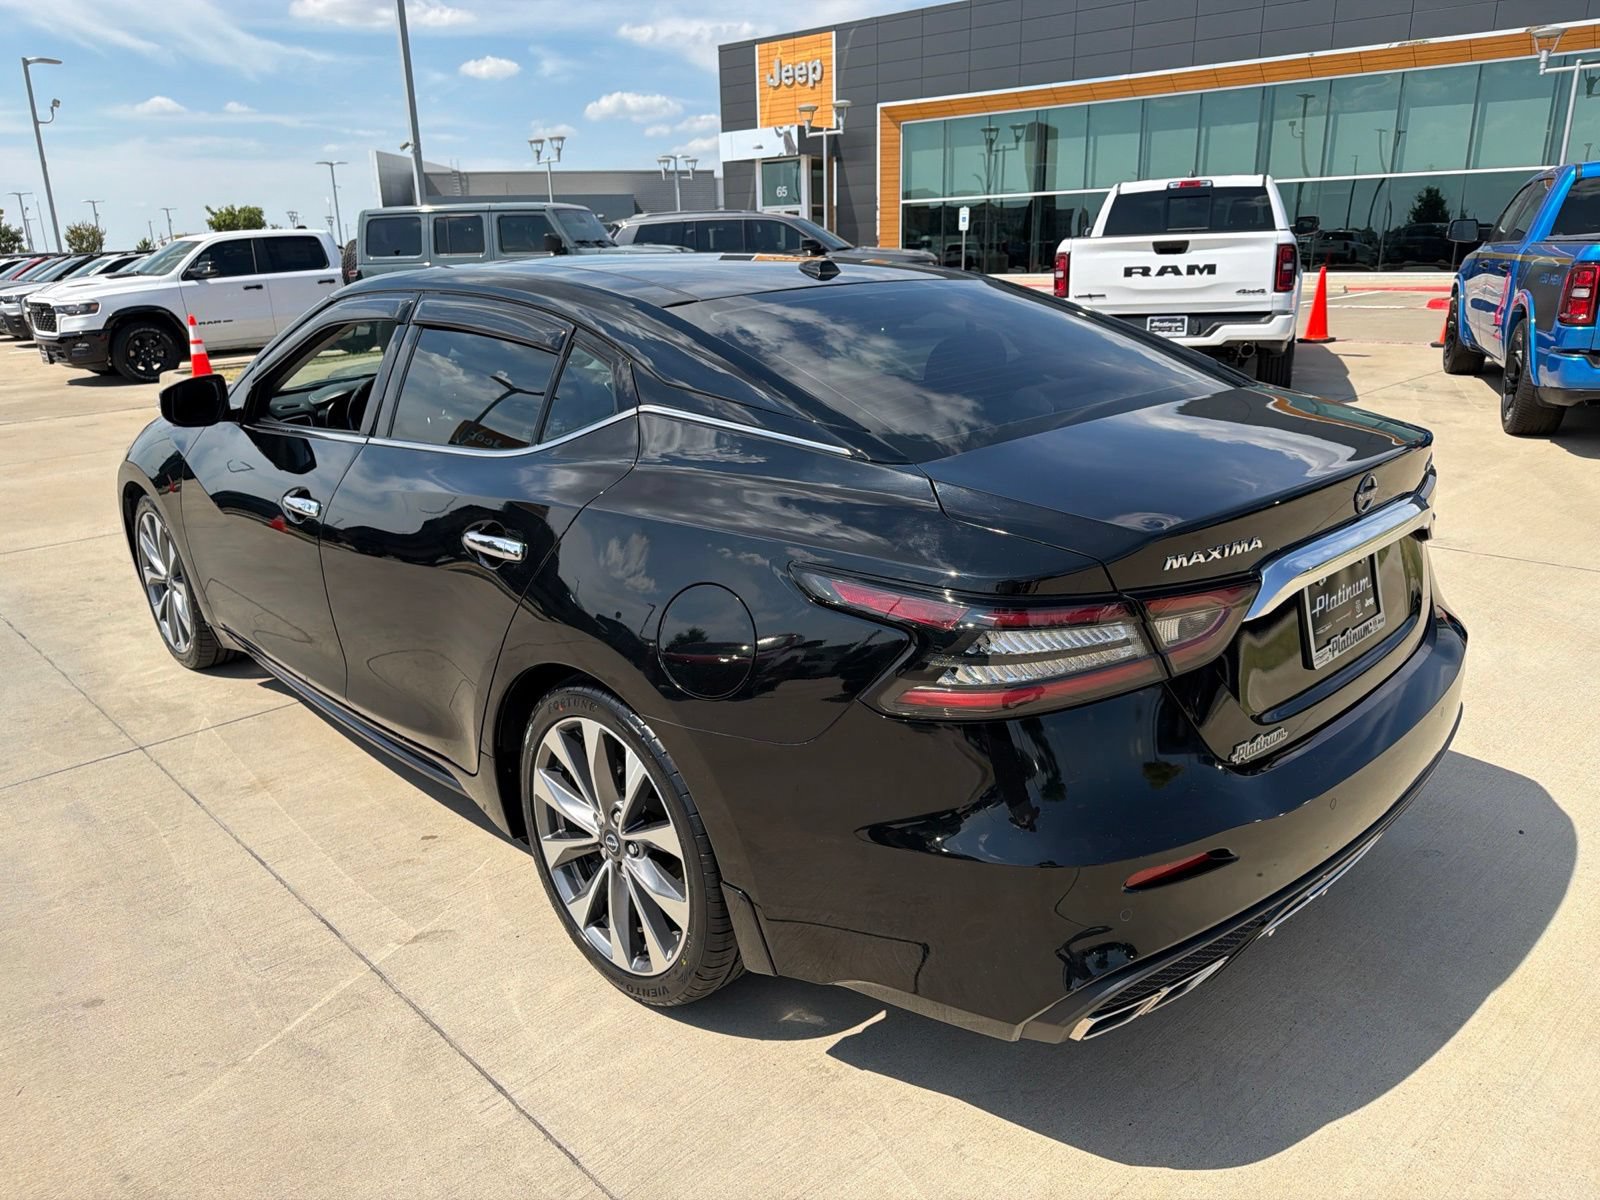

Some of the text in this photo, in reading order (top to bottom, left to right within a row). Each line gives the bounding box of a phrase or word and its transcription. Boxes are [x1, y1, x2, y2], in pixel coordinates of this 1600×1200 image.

[767, 58, 824, 88] Jeep
[776, 185, 788, 198] 65
[1123, 263, 1217, 278] RAM
[1163, 536, 1263, 571] MAXIMA
[1312, 576, 1373, 617] Platinum
[1331, 623, 1373, 657] Platinum
[1231, 727, 1288, 764] Platinum
[626, 982, 669, 998] VIENTO
